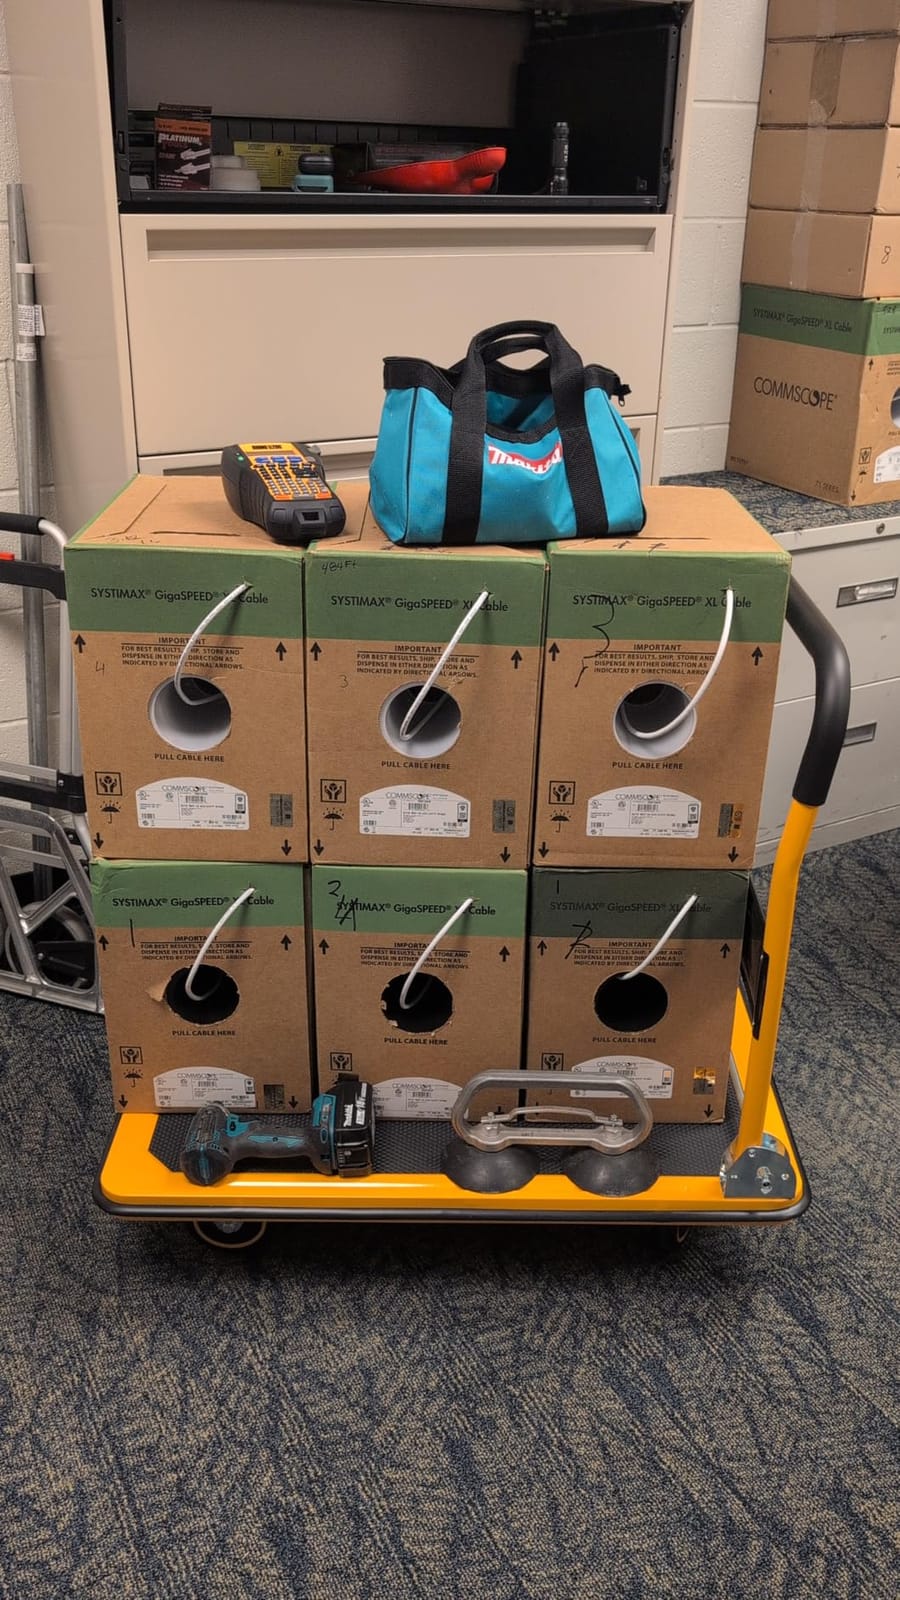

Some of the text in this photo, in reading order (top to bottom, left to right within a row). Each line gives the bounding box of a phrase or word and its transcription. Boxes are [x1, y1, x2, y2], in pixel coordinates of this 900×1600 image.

[158, 133, 200, 146] PLATINUM
[834, 322, 852, 332] Cable
[704, 596, 718, 607] XL
[721, 596, 752, 608] Cble
[403, 761, 428, 769] CABLE
[328, 880, 342, 897] 2
